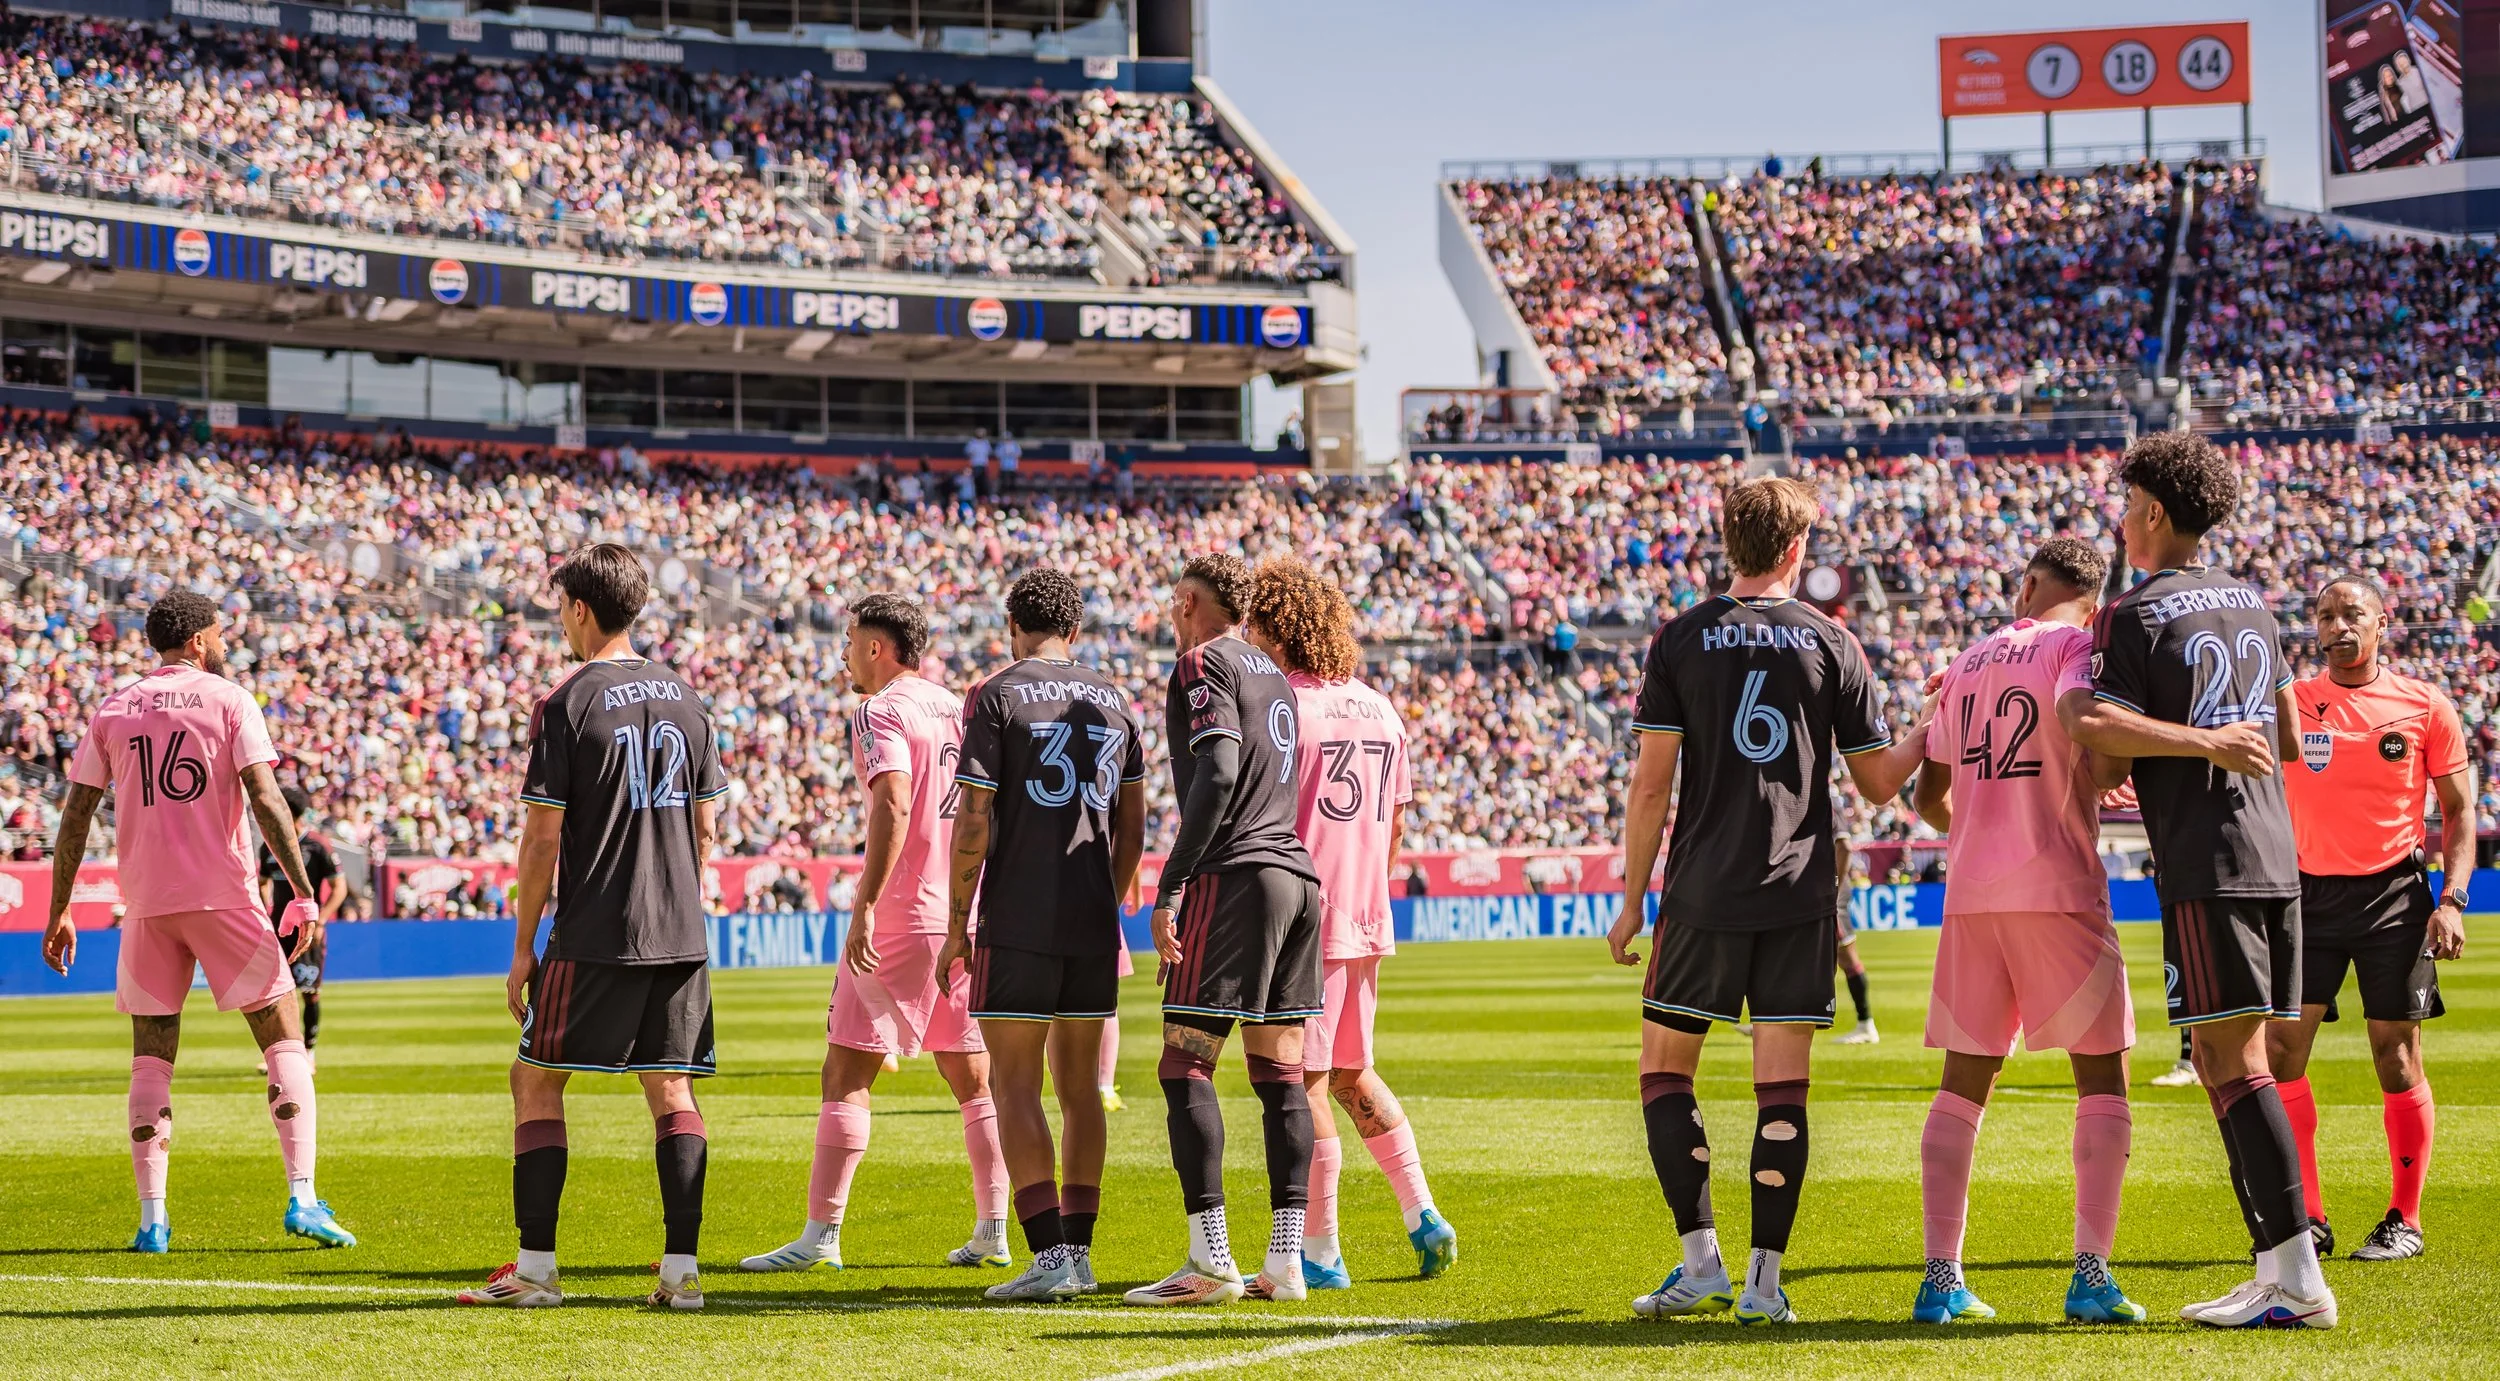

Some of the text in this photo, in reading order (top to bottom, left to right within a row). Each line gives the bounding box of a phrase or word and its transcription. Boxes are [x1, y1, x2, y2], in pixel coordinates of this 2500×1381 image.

[200, 0, 250, 22] issues
[511, 29, 548, 51] with
[590, 37, 620, 58] and
[621, 39, 685, 63] location
[2186, 47, 2223, 78] 44
[2045, 56, 2061, 88] 7
[2114, 53, 2147, 84] 18
[0, 211, 109, 259] PEPSI
[270, 243, 368, 288] PEPSI
[531, 271, 631, 313] PEPSI
[792, 291, 899, 329] PEPSI
[1079, 304, 1192, 339] PEPSI
[2150, 586, 2265, 624] HERRINGTON
[1702, 622, 1818, 651] HOLDING
[604, 679, 682, 712] ATENCIO
[1014, 680, 1122, 712] THOMPSON
[2184, 628, 2277, 728] 22
[126, 691, 204, 716] M. SILVA
[1733, 670, 1789, 764] 6
[1268, 698, 1296, 784] 9
[1961, 685, 2043, 781] 42
[2304, 734, 2331, 745] FIFA
[2385, 743, 2402, 751] PRO
[129, 730, 208, 808] 16
[614, 719, 689, 810] 12
[1025, 721, 1125, 812] 33
[1317, 740, 1395, 822] 37
[1411, 895, 1539, 941] AMERICAN
[729, 913, 828, 968] FAMILY
